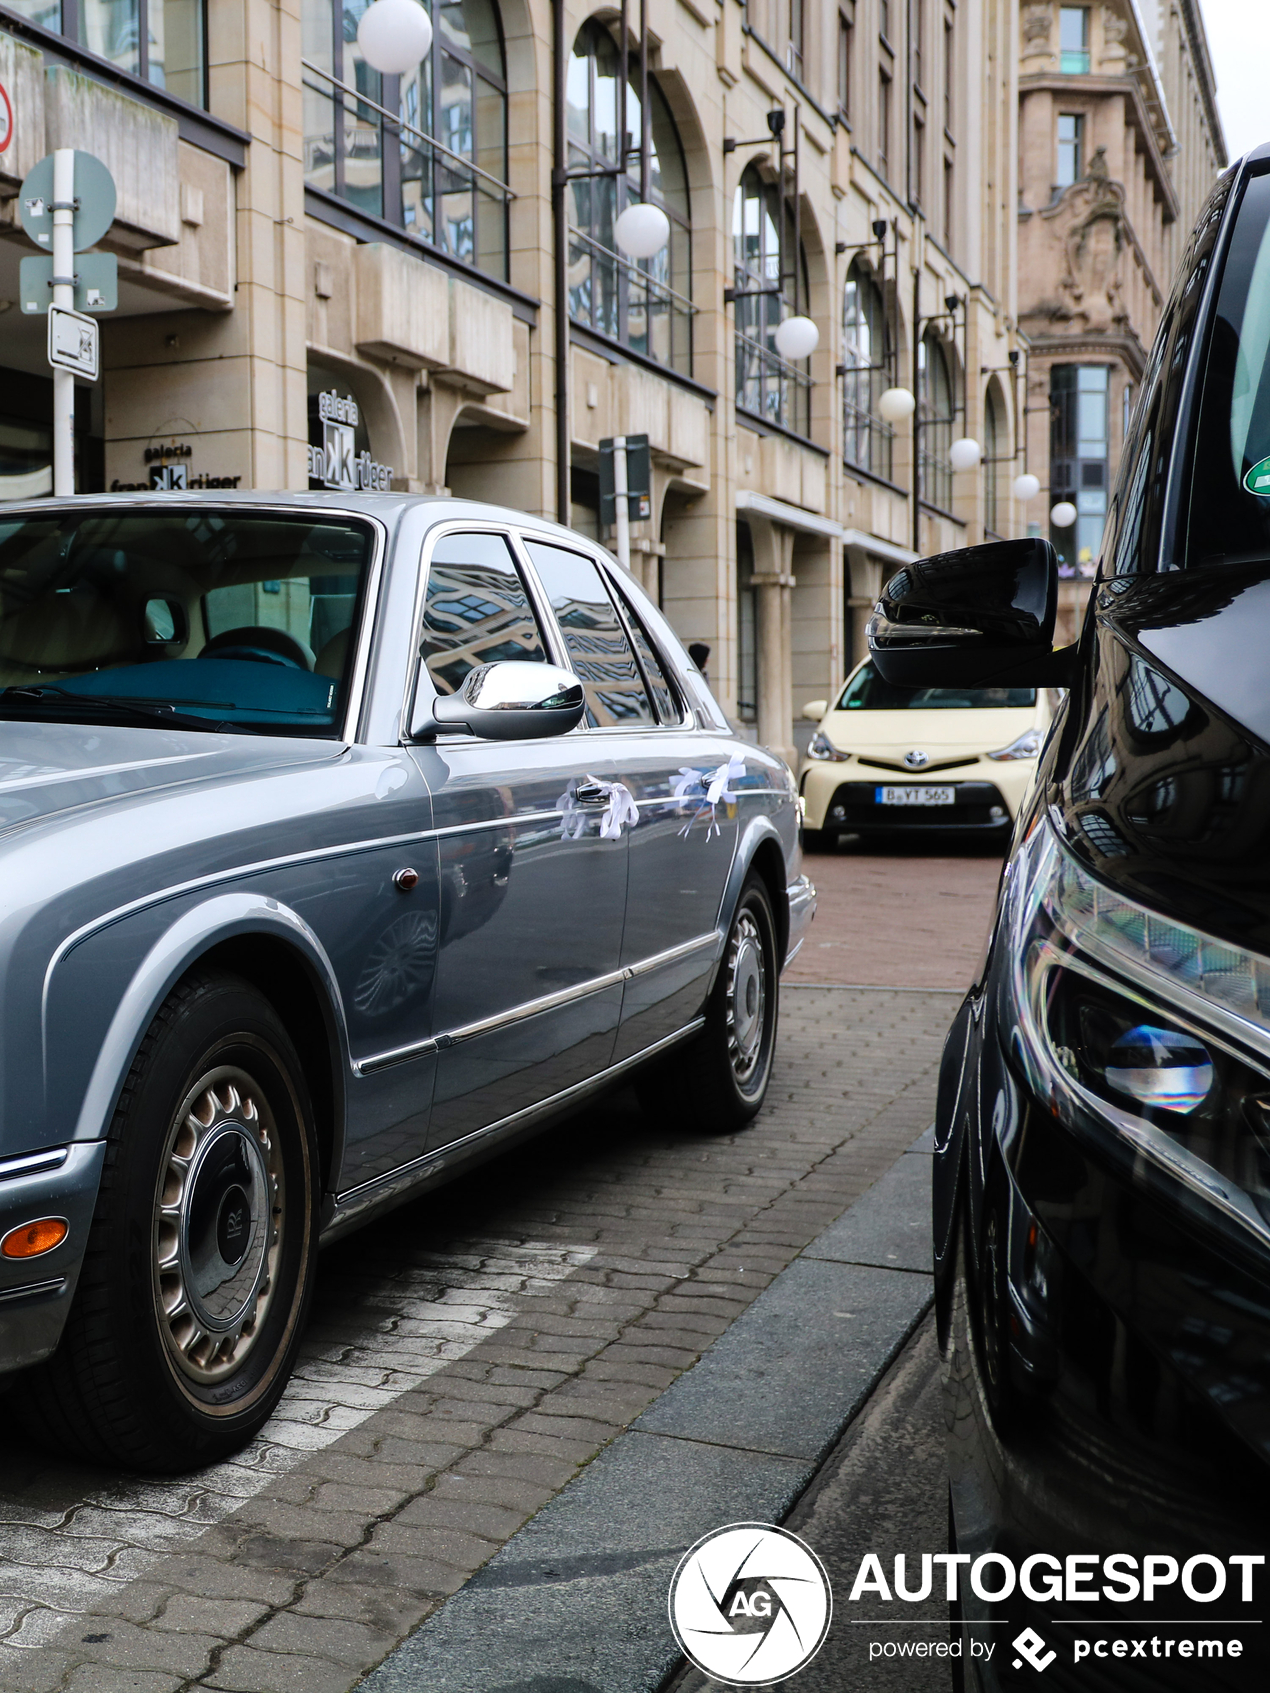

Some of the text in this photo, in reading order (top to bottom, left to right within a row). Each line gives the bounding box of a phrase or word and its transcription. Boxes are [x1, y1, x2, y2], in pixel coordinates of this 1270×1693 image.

[319, 389, 358, 426] galeria
[144, 443, 192, 463] galeria
[887, 790, 895, 801] B
[925, 790, 949, 801] 565
